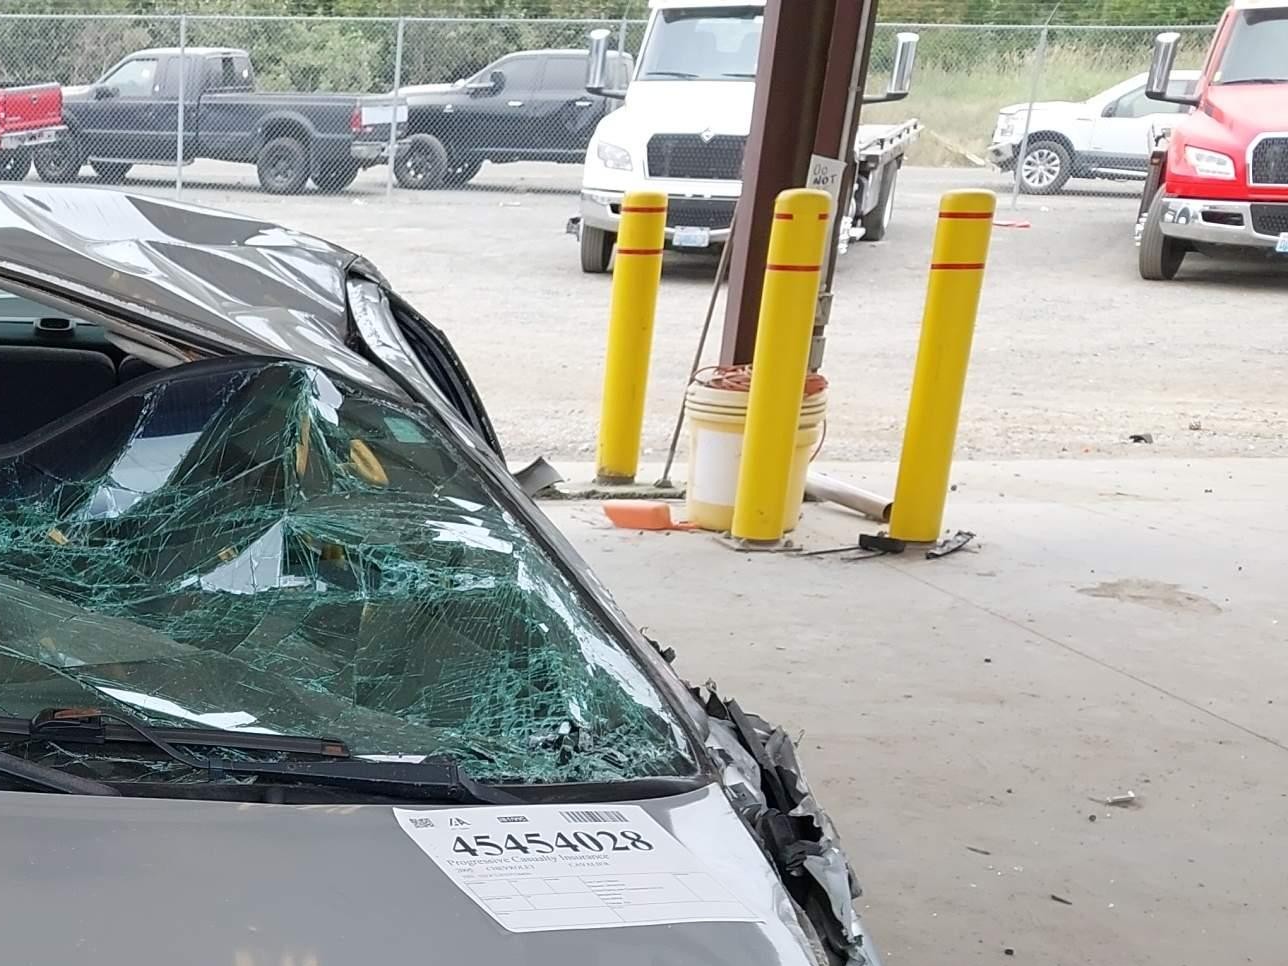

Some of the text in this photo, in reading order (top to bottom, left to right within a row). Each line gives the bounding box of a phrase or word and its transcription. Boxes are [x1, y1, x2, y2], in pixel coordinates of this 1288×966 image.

[813, 174, 838, 185] NOT
[452, 830, 654, 857] 45454028
[447, 853, 610, 866] Progressive Casualty Insurance
